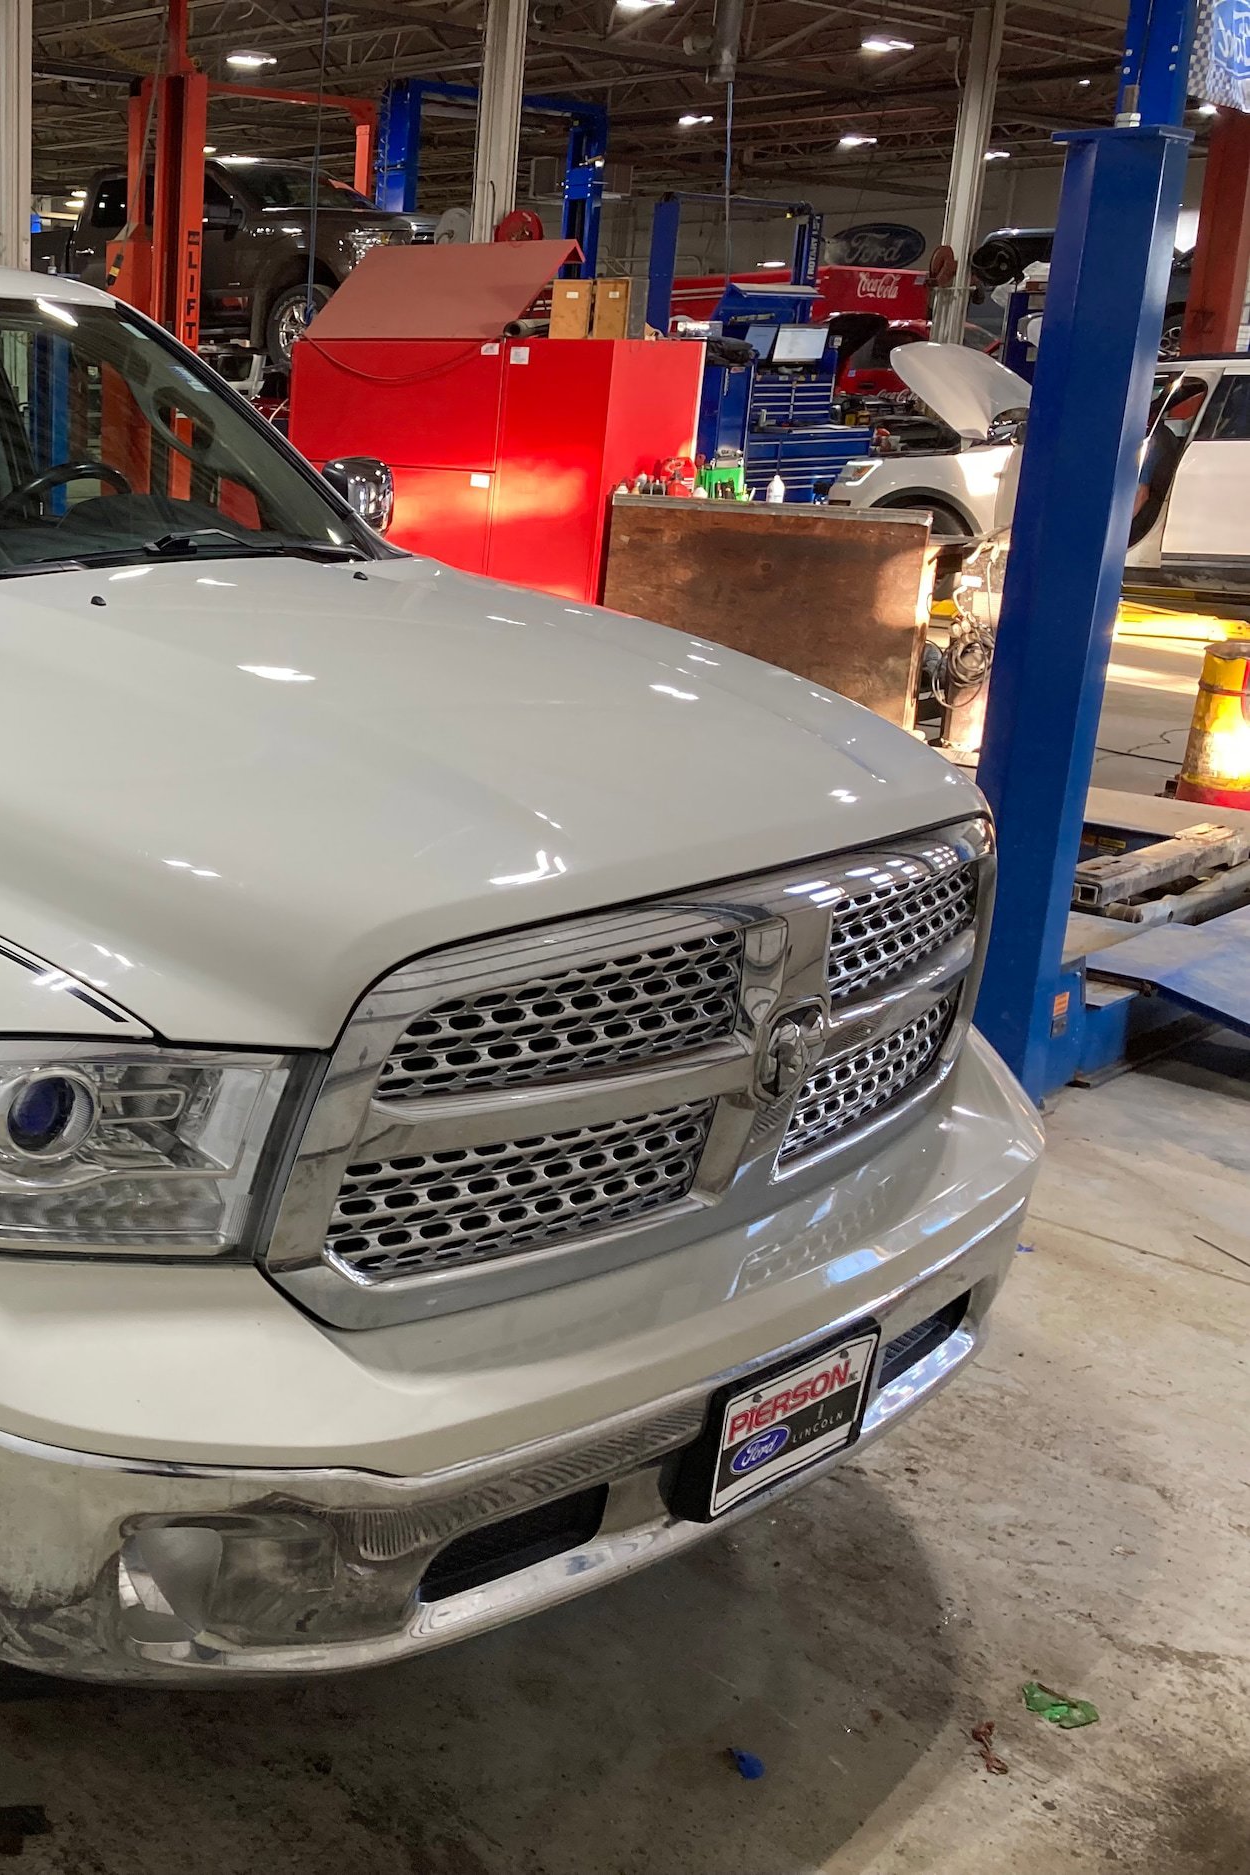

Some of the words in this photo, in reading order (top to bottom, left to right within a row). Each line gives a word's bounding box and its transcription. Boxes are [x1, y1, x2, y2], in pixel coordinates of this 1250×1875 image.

[727, 1359, 851, 1445] PIERSON
[792, 1410, 845, 1444] LINCOLN
[741, 1434, 779, 1468] Ford
